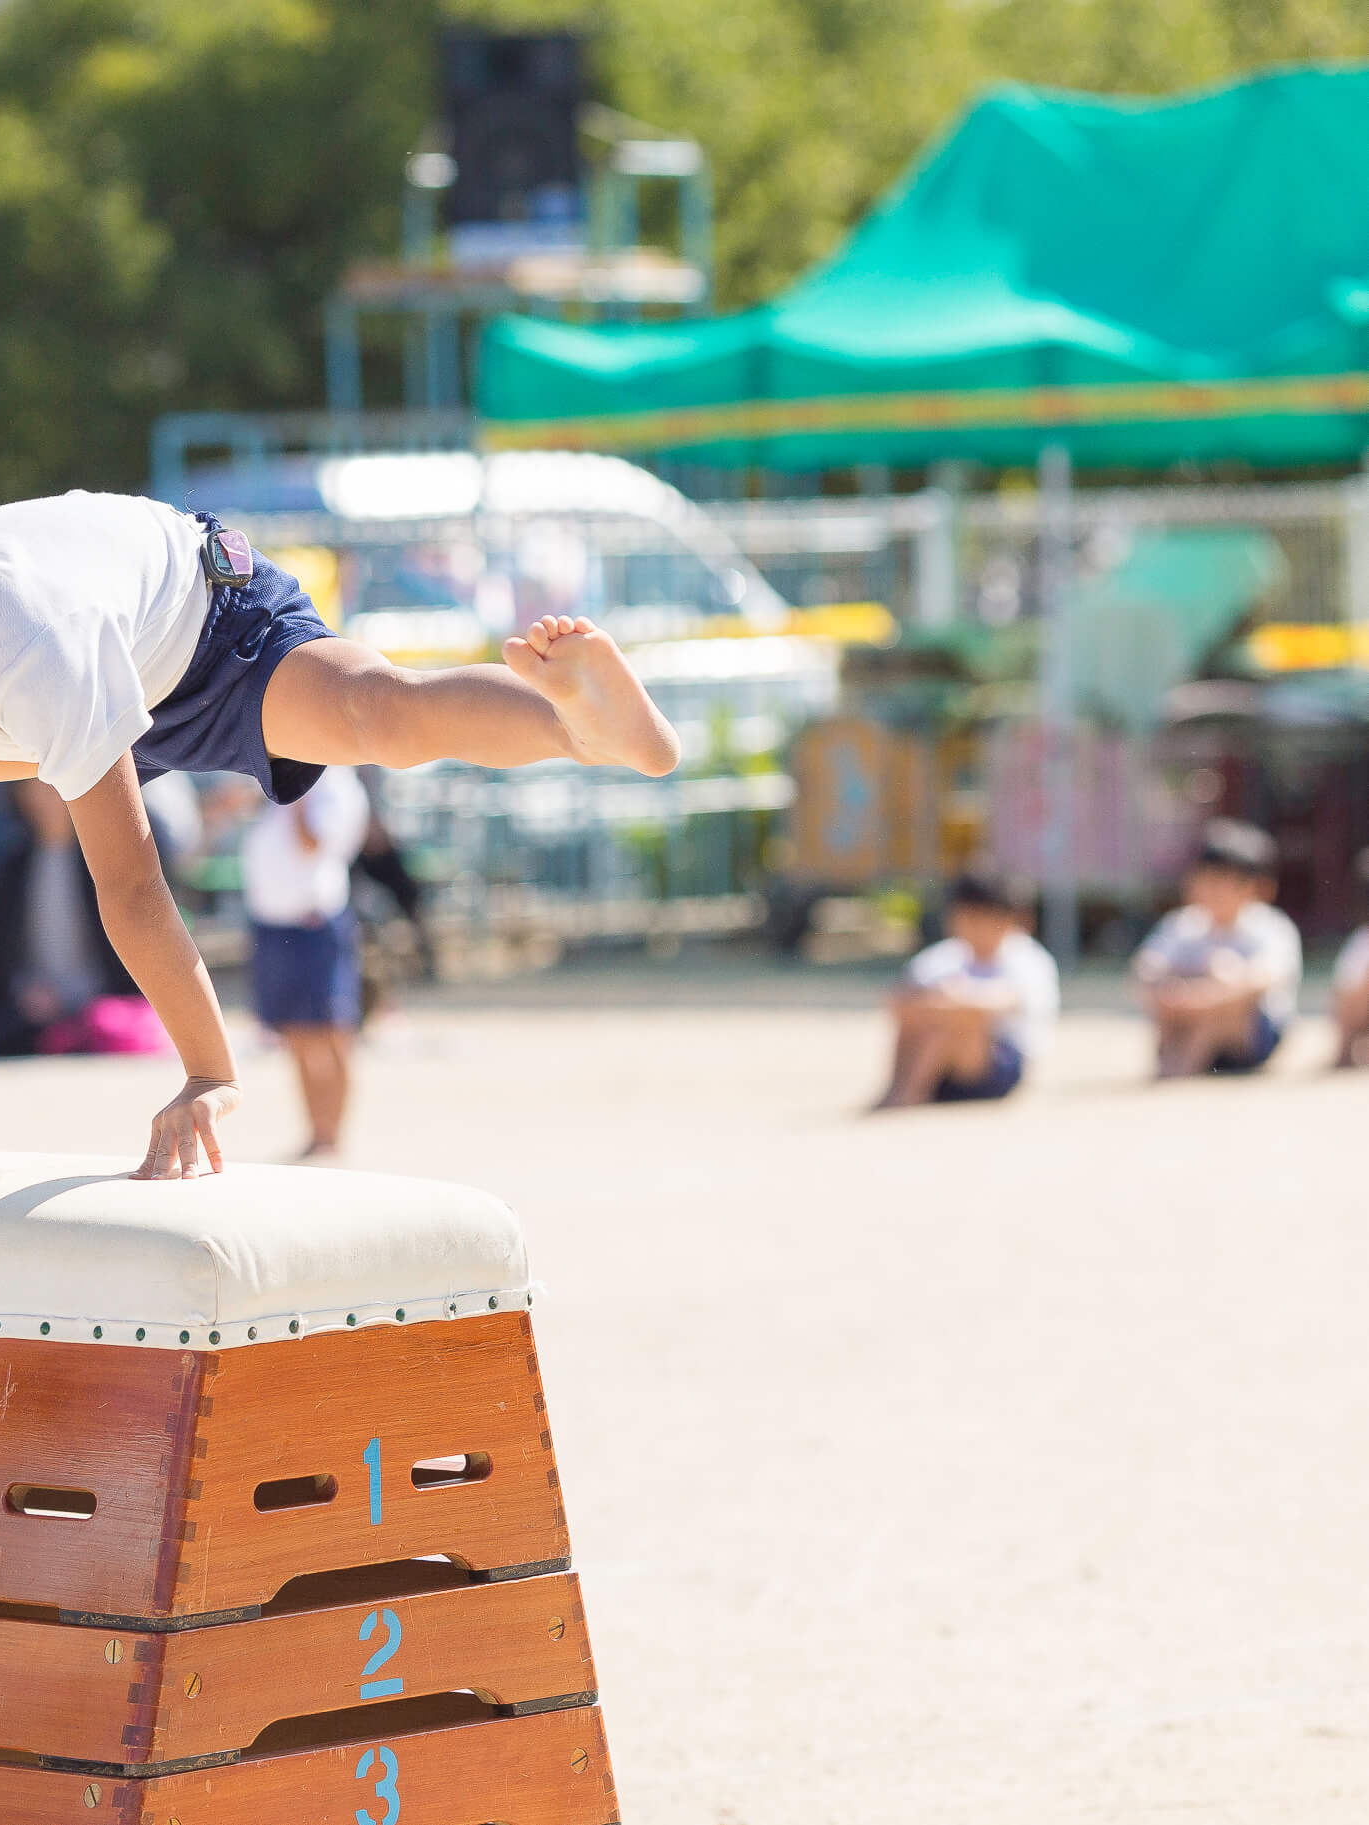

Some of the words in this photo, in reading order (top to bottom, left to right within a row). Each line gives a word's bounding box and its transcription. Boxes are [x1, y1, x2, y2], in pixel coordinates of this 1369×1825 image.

[363, 1437, 382, 1525] 1
[358, 1609, 404, 1700] 2
[355, 1746, 400, 1825] 3
